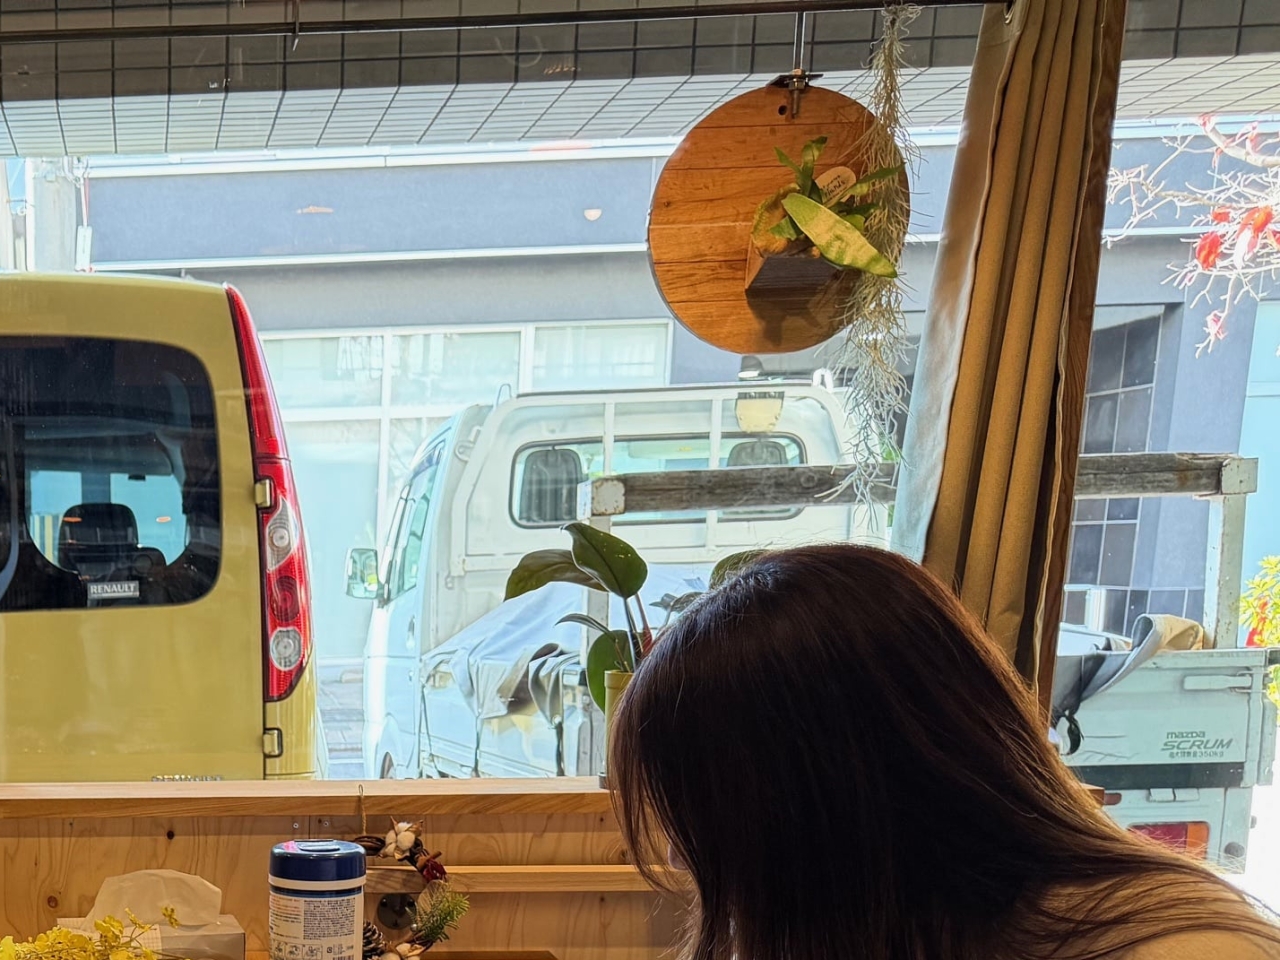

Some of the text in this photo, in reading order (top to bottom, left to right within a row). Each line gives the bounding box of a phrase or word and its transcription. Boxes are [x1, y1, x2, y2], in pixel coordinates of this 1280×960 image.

[90, 583, 135, 594] RENAULT
[1166, 731, 1206, 739] mazda
[1161, 738, 1233, 751] SCRUM
